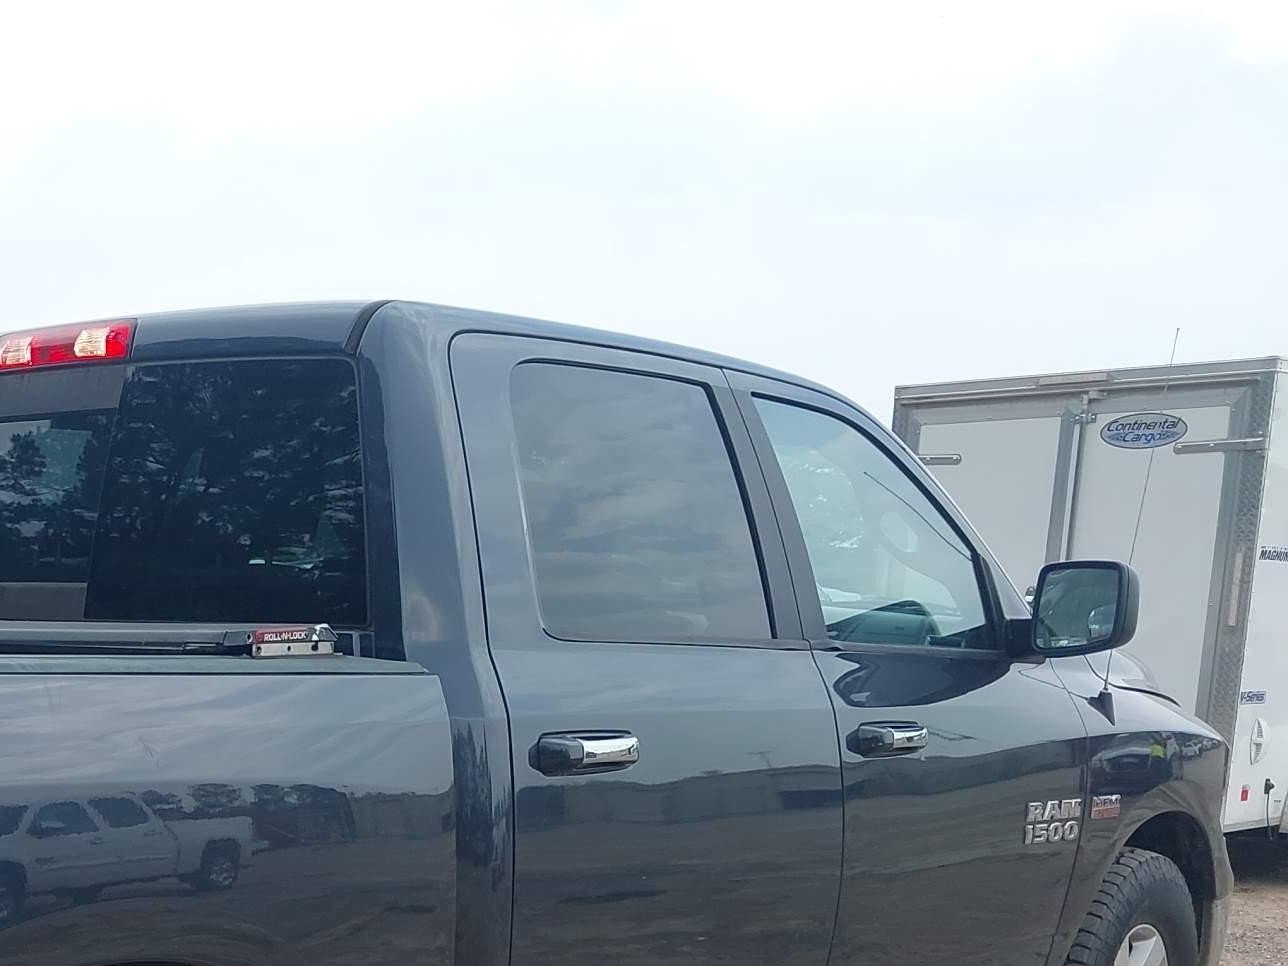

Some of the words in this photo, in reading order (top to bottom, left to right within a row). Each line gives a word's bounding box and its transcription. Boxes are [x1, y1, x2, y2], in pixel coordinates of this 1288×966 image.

[1107, 418, 1181, 432] Continental
[1123, 431, 1161, 444] Cargo
[1026, 798, 1082, 821] RAM
[1024, 820, 1079, 845] 1500
